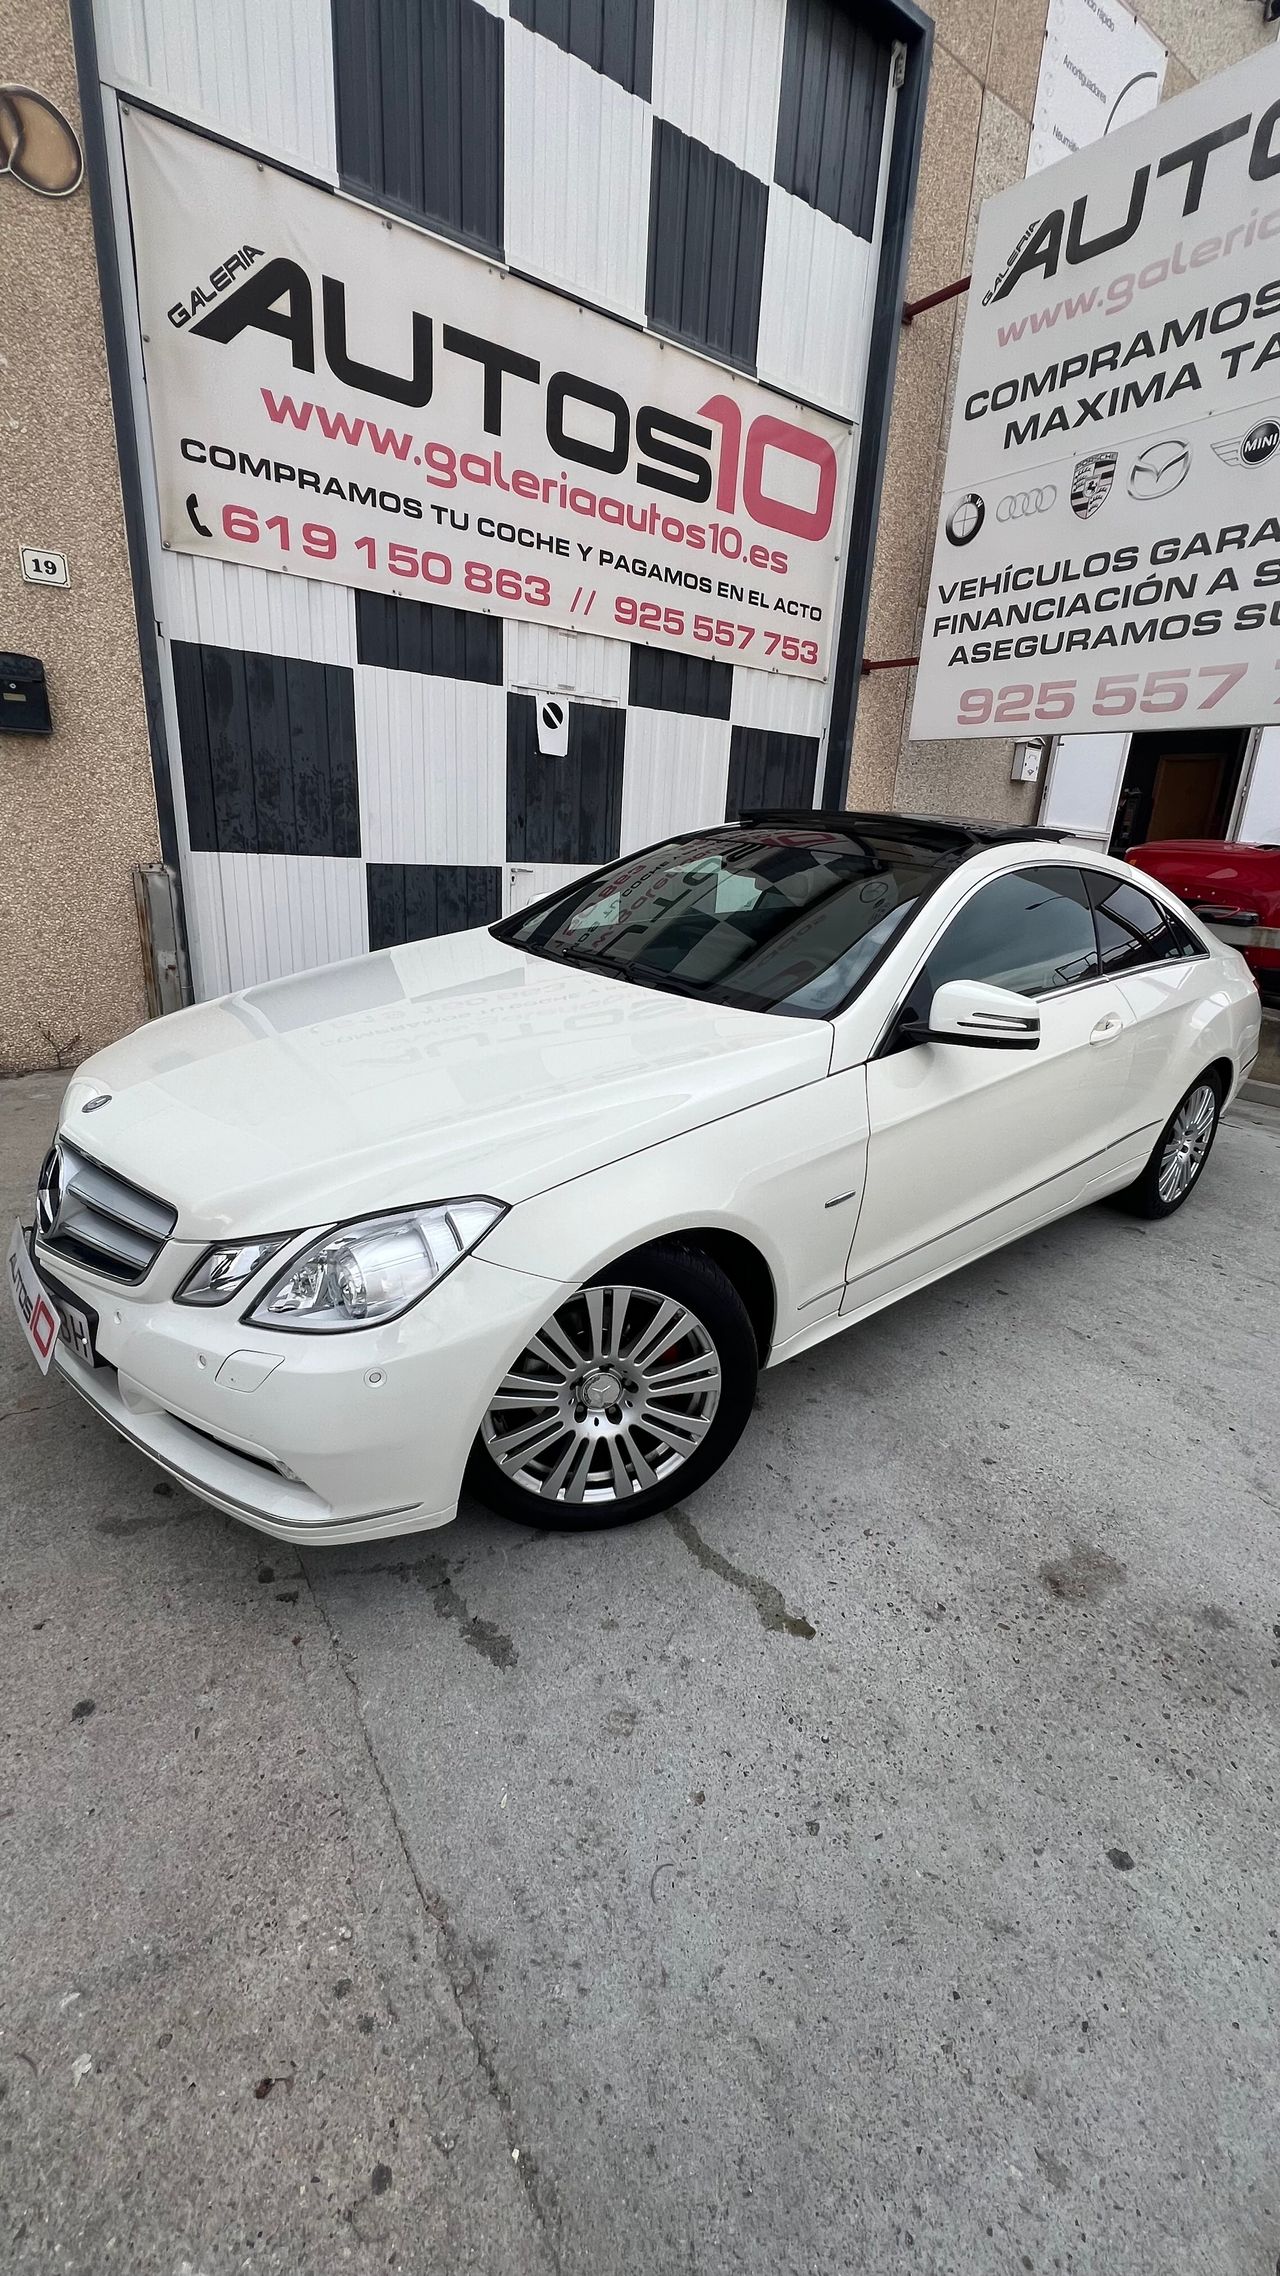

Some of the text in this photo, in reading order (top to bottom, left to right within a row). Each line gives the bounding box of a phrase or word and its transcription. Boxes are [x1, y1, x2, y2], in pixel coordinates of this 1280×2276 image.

[167, 245, 266, 329] GALERIA
[980, 218, 1041, 307] GALERIA
[964, 279, 1280, 421] COMPRAMOS
[188, 257, 837, 542] AUTOS10
[1003, 361, 1202, 450] MAXIMA
[1244, 433, 1279, 453] MINI
[260, 387, 788, 575] www.galeriaautos10.es
[31, 558, 58, 576] 19
[180, 437, 823, 622] COMPRAMOS TU COCHE Y PAGAMOS EN EL ACTO
[938, 516, 1280, 605] VEHÍCULOS GARA
[221, 503, 338, 560] 619
[354, 536, 452, 585] 150
[463, 560, 552, 607] 863
[614, 595, 685, 637] 925
[692, 616, 756, 650] 557
[763, 631, 820, 666] 753
[932, 573, 1199, 638] FINANCIACIÓN
[1205, 566, 1240, 596] A
[947, 609, 1223, 667] ASEGURAMOS
[956, 679, 1078, 726] 925
[1091, 662, 1249, 718] 557
